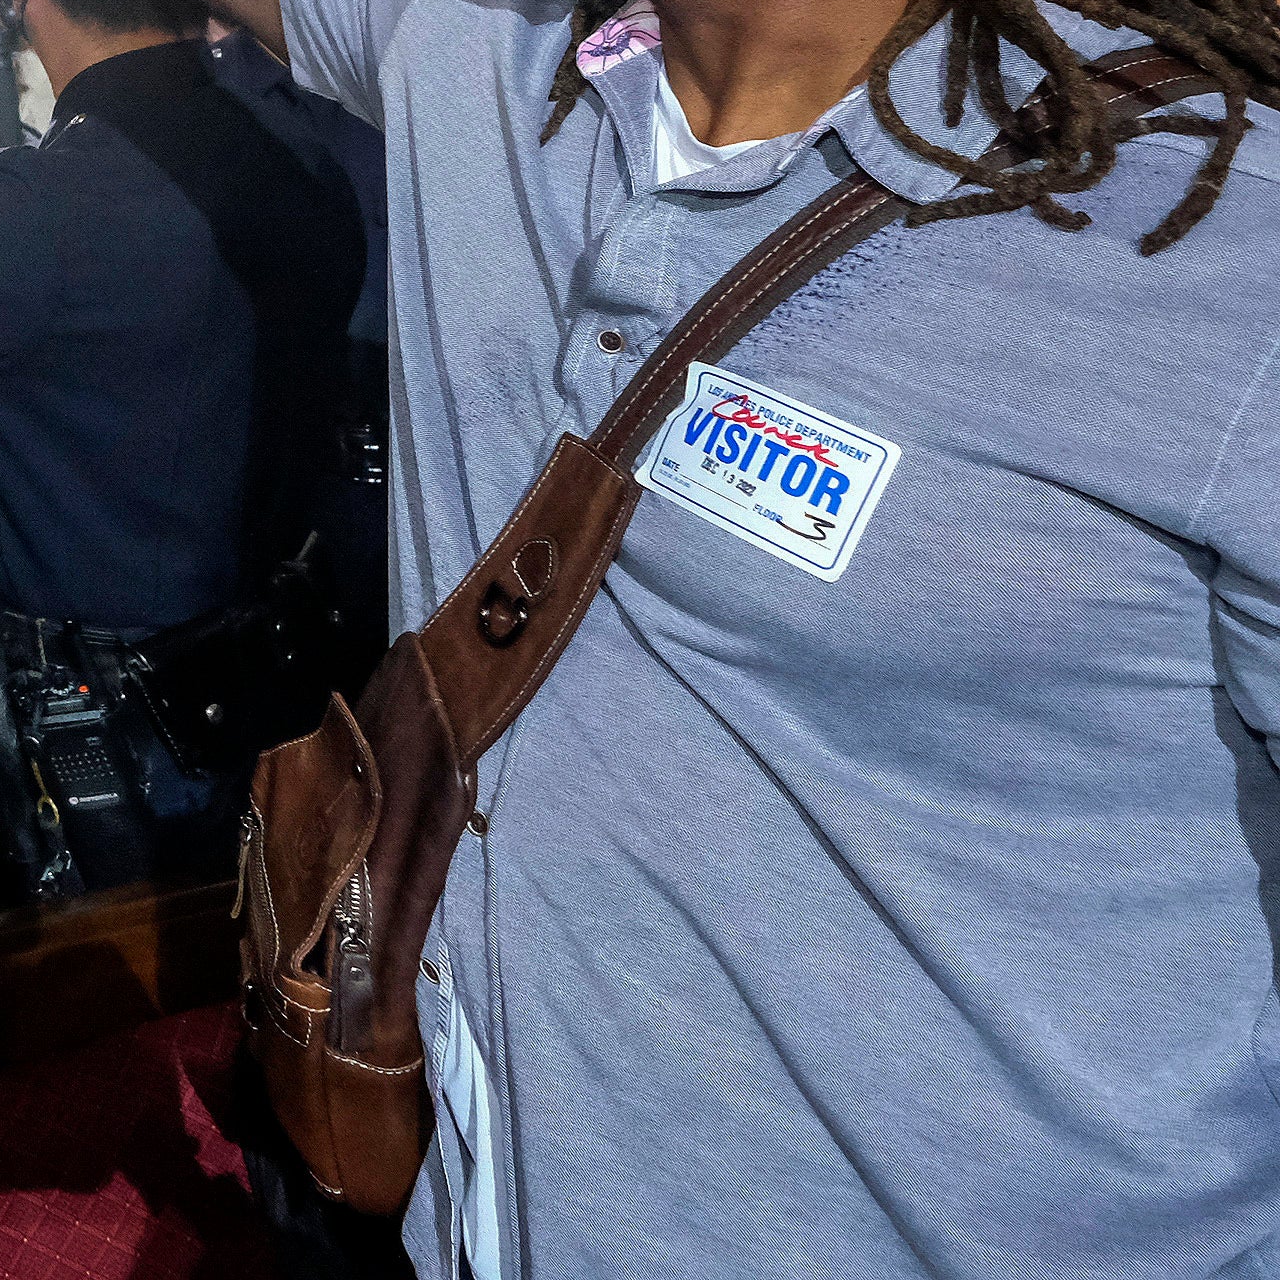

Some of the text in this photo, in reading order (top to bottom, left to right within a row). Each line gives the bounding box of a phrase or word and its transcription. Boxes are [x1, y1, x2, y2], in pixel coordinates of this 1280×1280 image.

[683, 407, 852, 517] VISITOR
[757, 405, 793, 429] POLICE
[794, 422, 872, 464] DEPARTMENT
